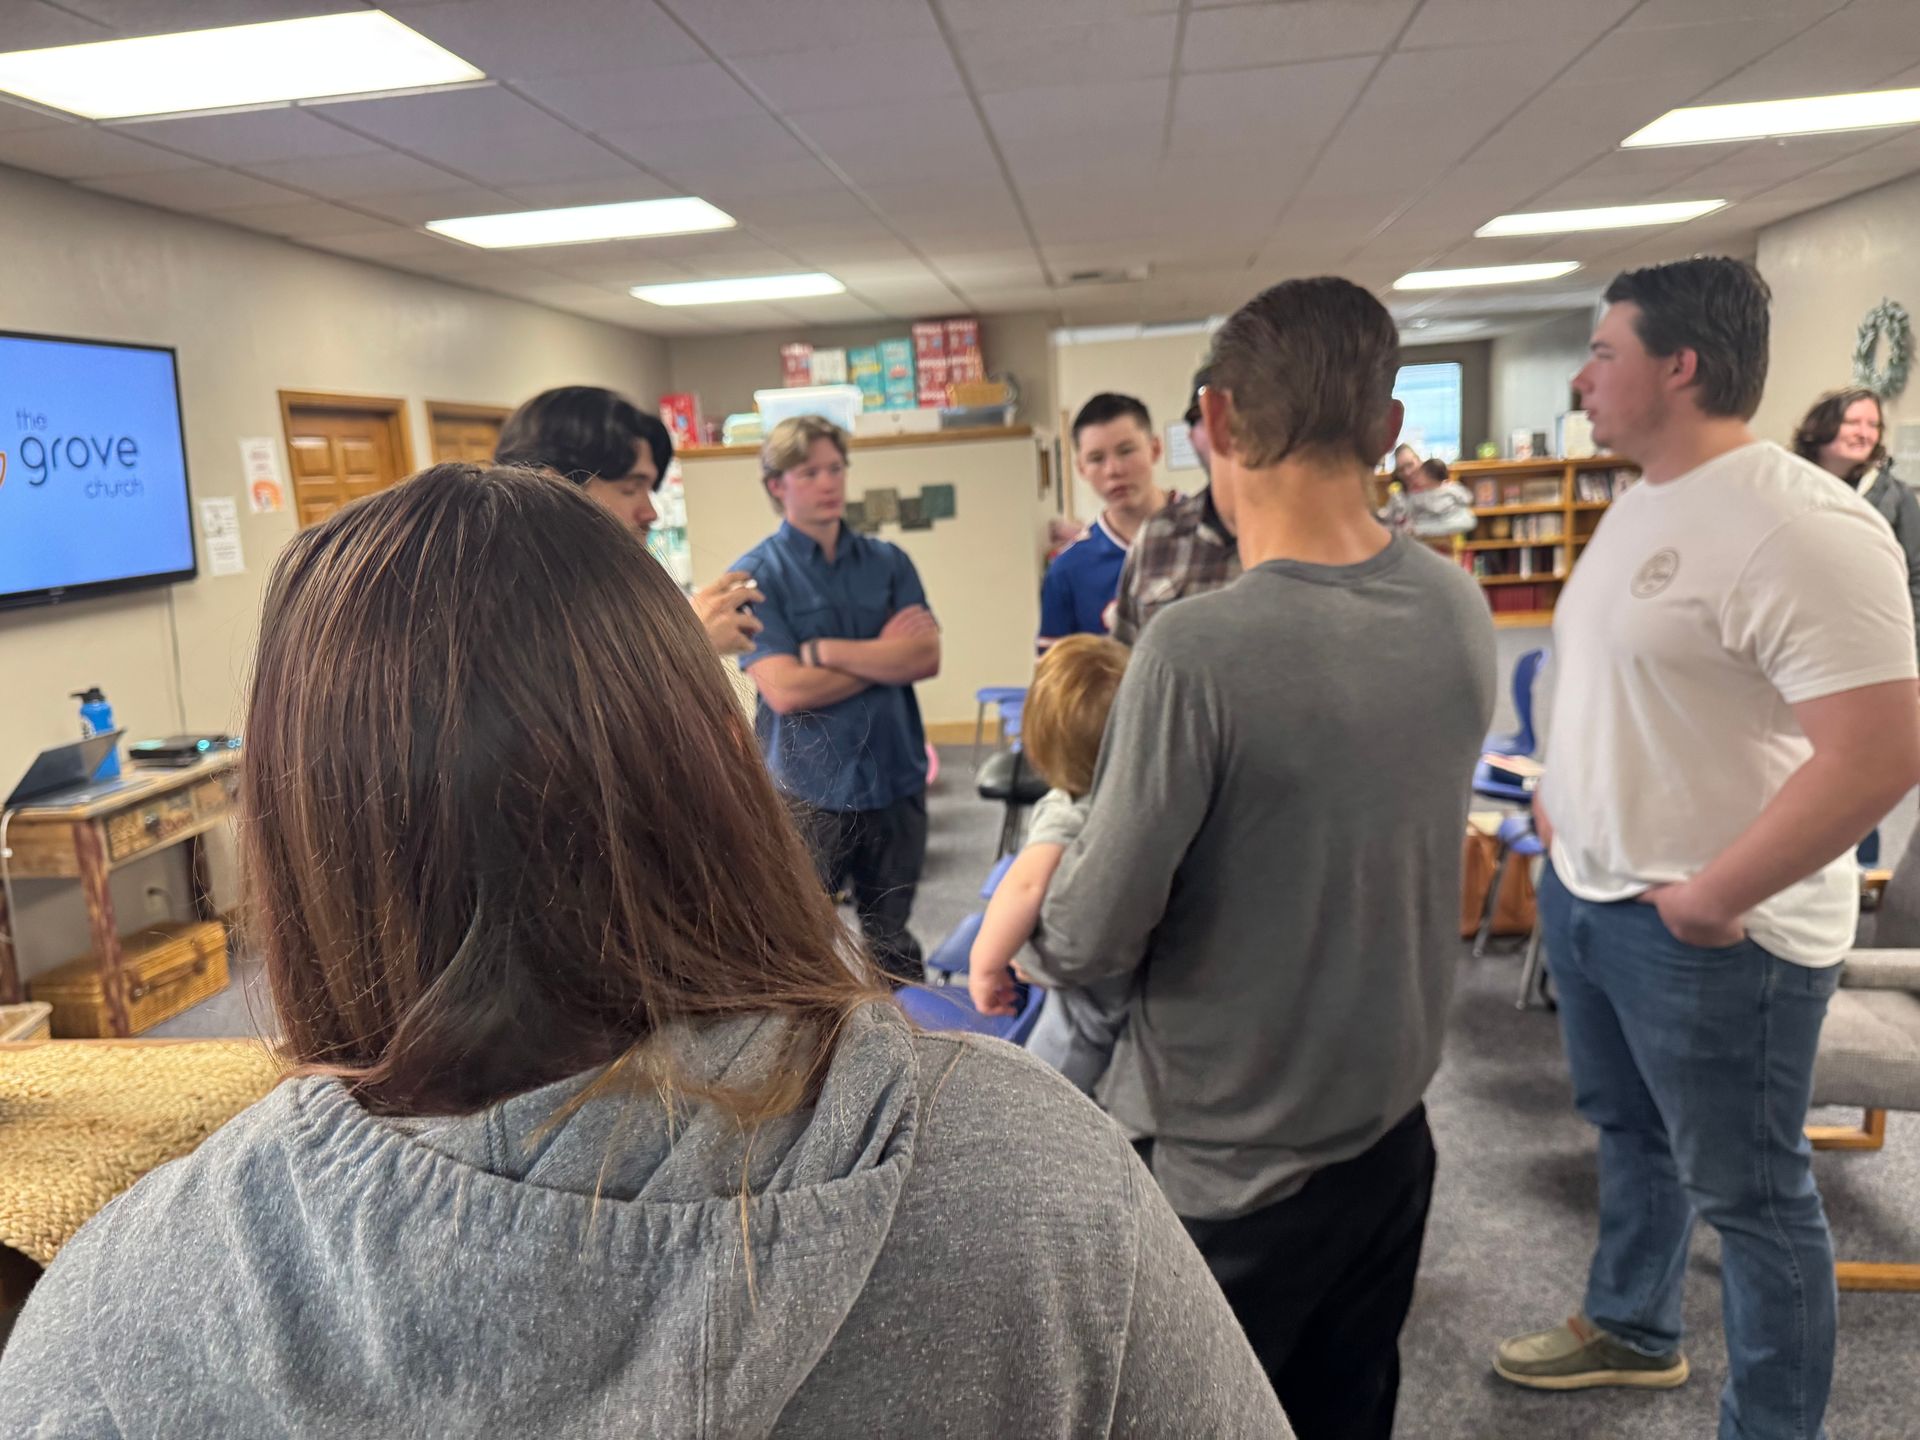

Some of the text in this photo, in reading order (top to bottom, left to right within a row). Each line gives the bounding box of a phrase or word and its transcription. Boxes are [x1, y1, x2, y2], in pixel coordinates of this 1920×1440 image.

[16, 408, 47, 430] the
[20, 435, 138, 487] grove
[84, 476, 144, 499] church
